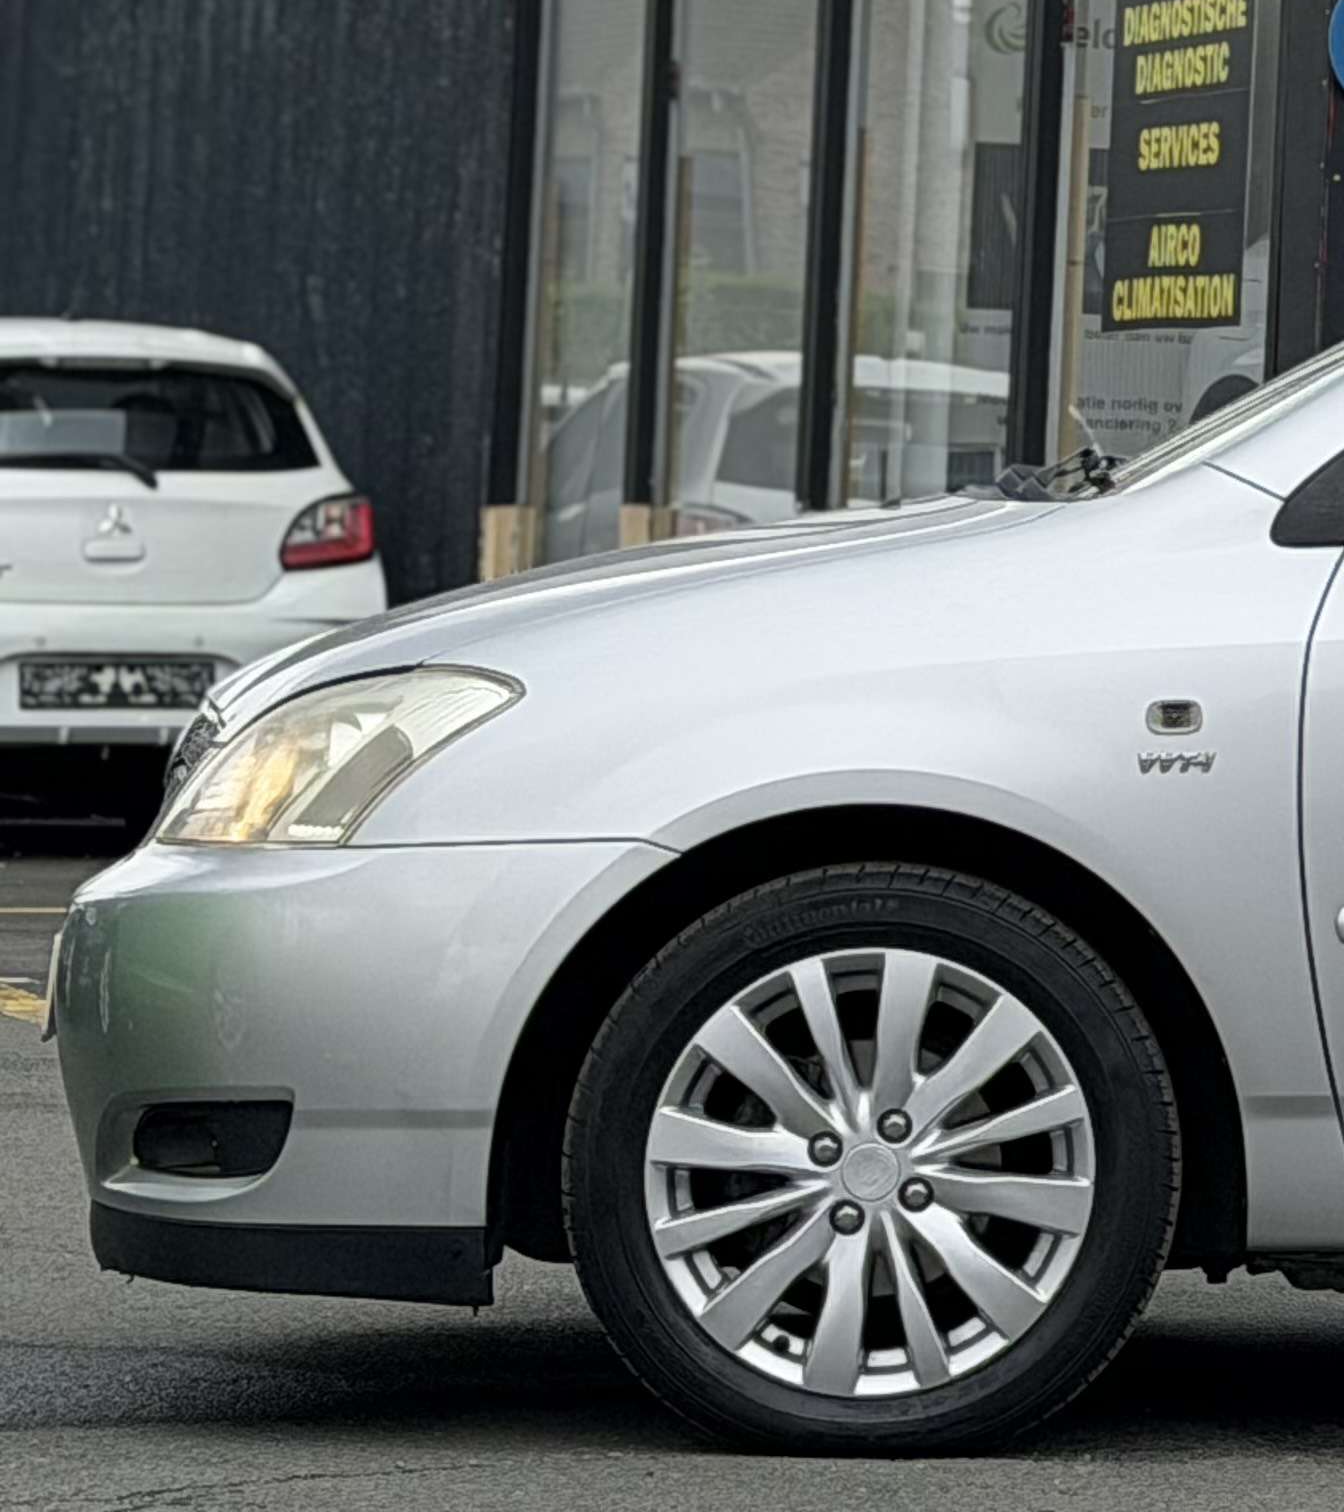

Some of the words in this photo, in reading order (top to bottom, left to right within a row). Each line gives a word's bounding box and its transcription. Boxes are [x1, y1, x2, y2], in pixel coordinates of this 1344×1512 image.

[1134, 41, 1230, 95] DIAGNOSTIC
[1138, 121, 1220, 171] SERVICES
[1147, 223, 1201, 268] AIRCO
[1111, 274, 1235, 322] CLIMATISATION
